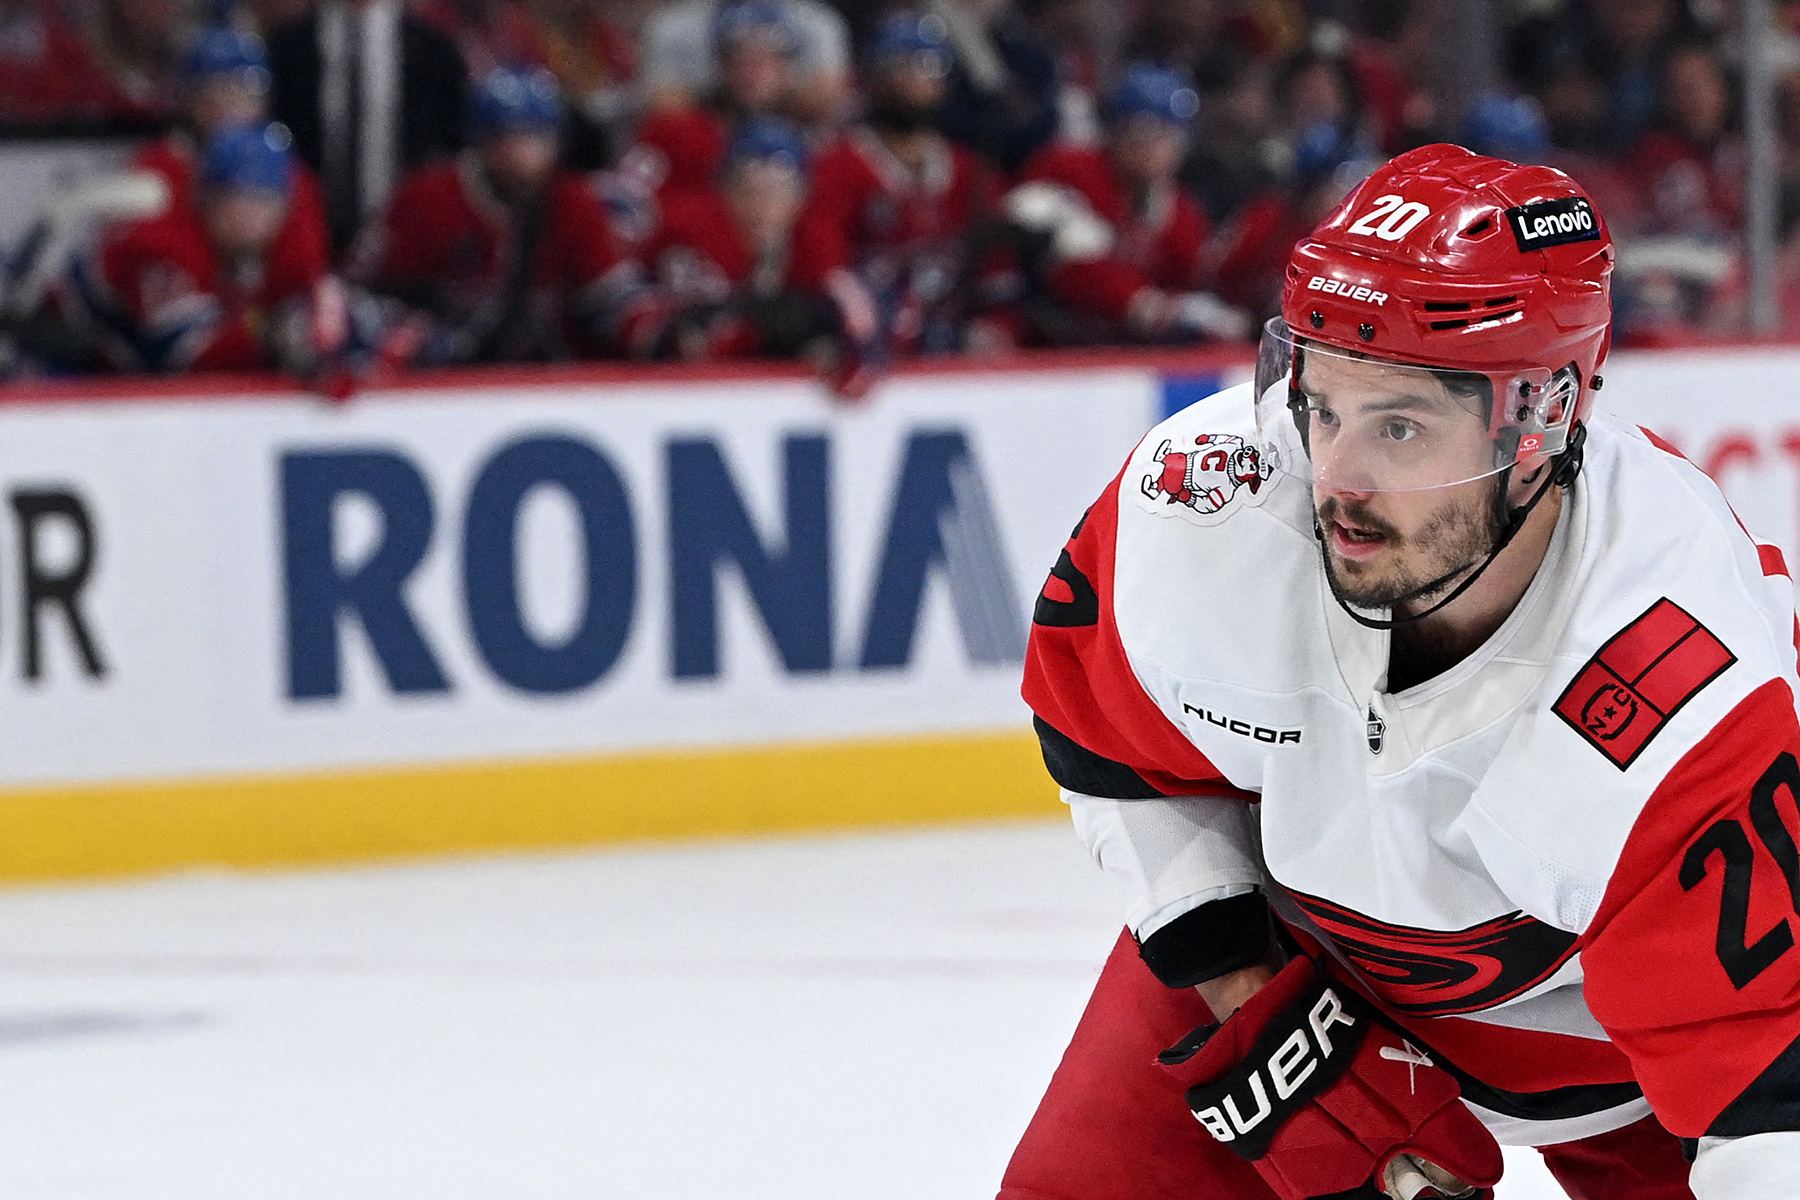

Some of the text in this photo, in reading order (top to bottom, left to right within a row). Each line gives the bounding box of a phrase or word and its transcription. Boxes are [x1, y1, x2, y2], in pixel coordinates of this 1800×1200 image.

[1348, 195, 1430, 241] 20
[1518, 211, 1592, 240] Lenovo
[275, 428, 1028, 702] RONA
[1184, 703, 1301, 744] NUCOR
[1191, 988, 1356, 1143] AUER
